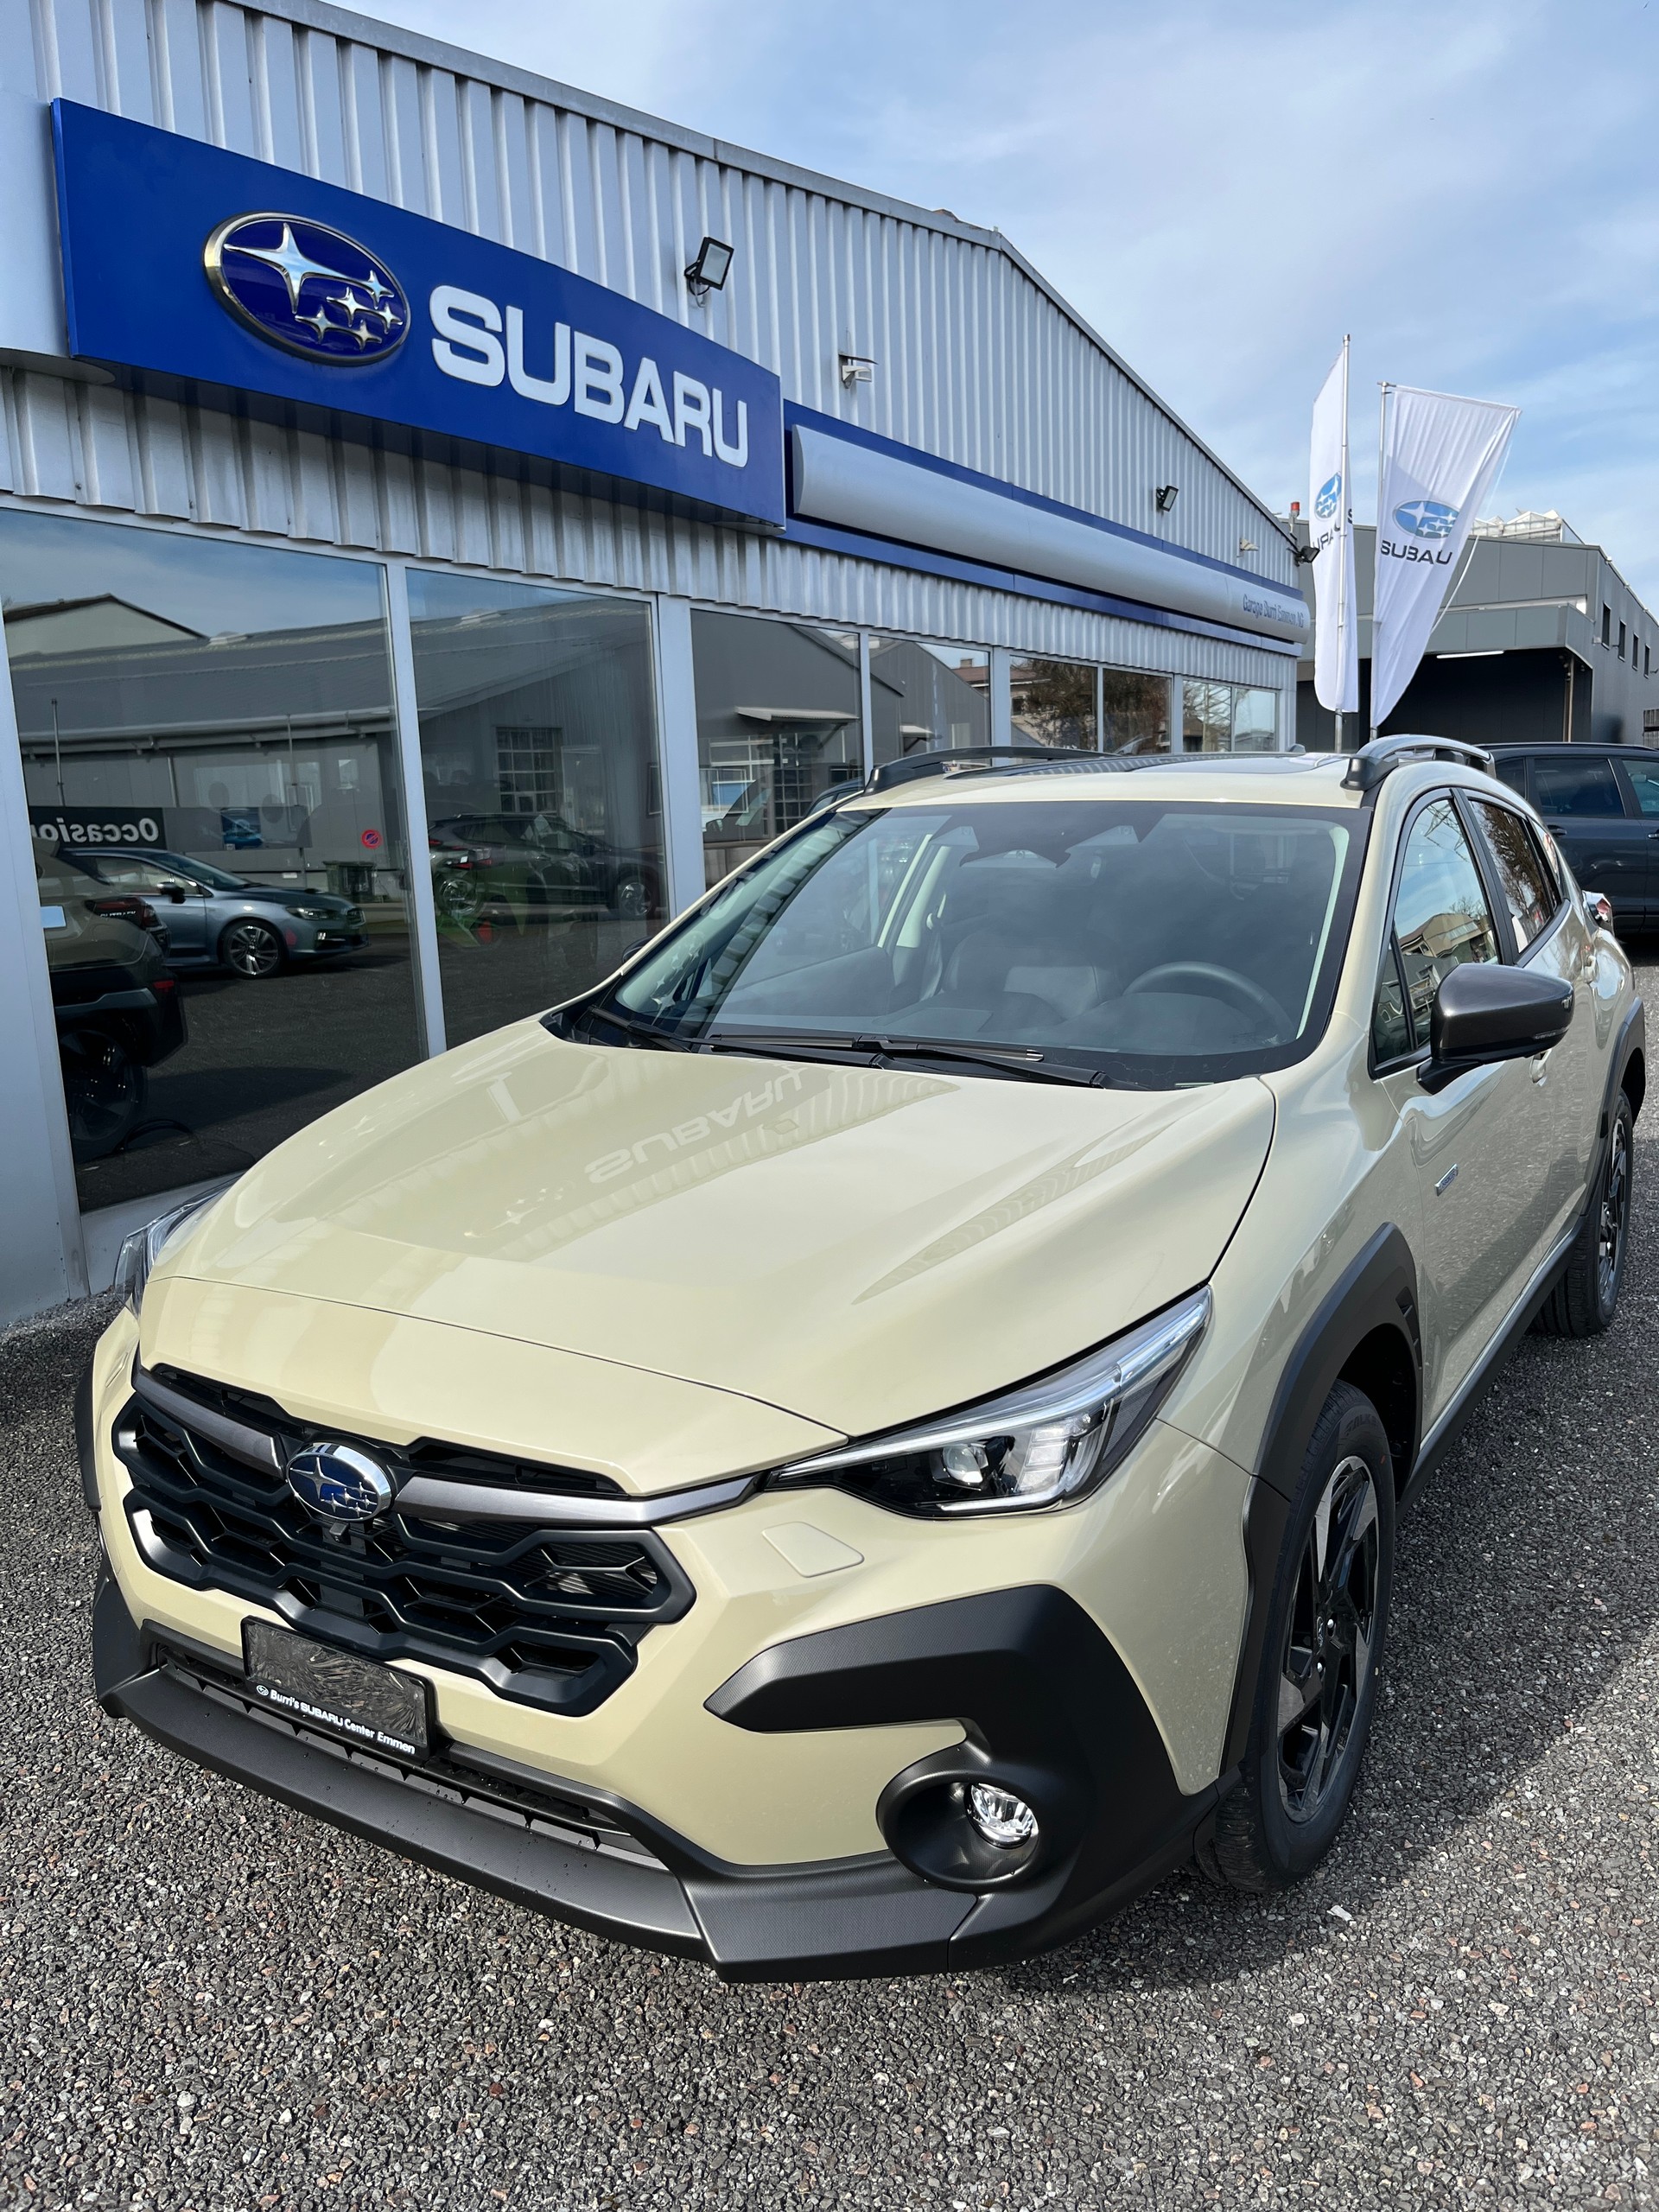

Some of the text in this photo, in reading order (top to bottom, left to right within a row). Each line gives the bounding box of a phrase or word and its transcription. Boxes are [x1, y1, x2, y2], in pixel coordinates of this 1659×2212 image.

[430, 285, 749, 468] SUBARU
[1381, 540, 1452, 565] SUBAU
[1243, 594, 1262, 619] Garage
[270, 1689, 416, 1754] Burri's SUBARU Center Emmen
